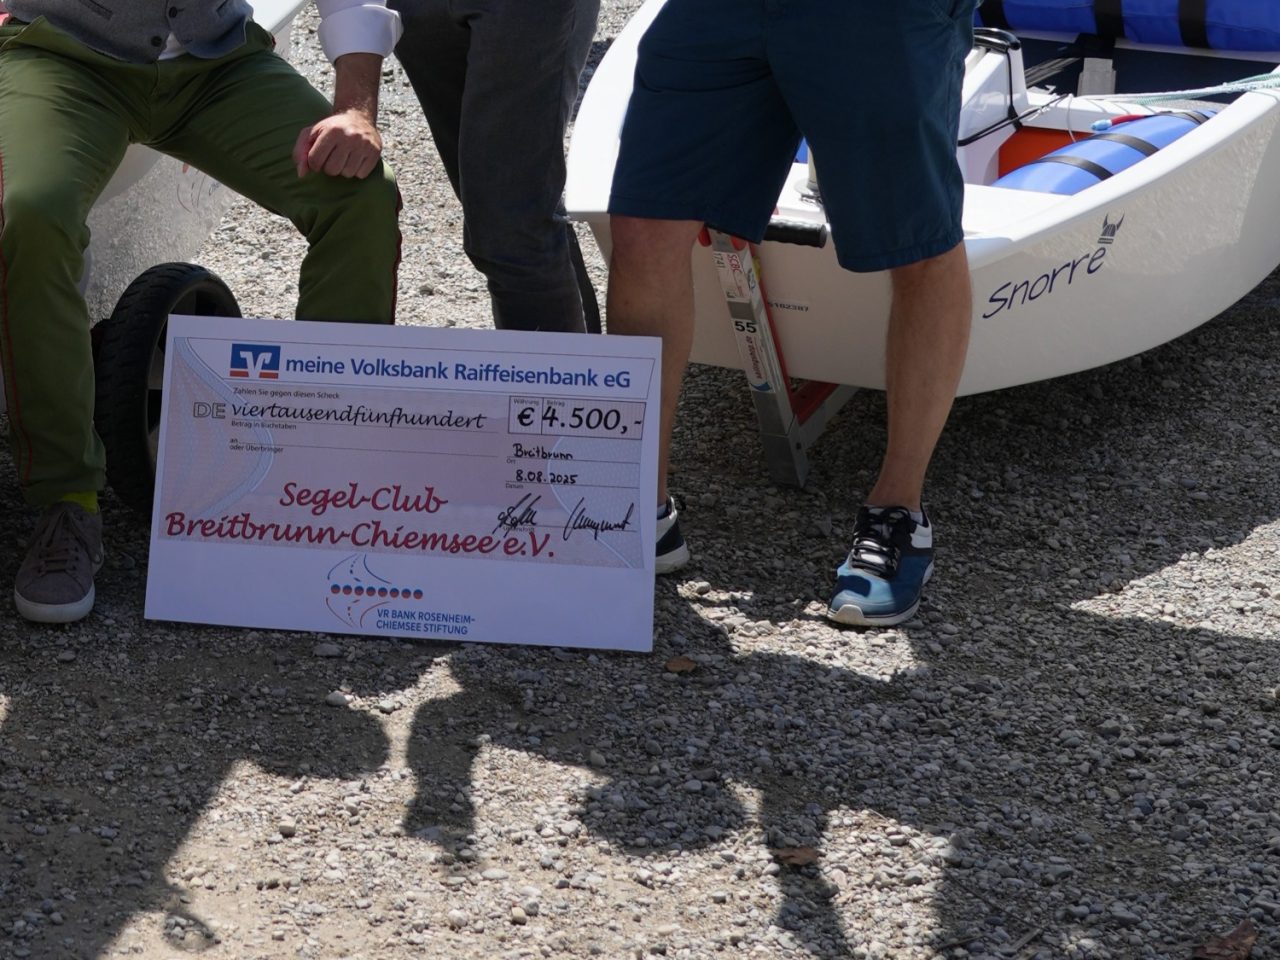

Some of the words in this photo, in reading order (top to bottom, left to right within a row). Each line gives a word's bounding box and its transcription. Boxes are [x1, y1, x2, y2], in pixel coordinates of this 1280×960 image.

[734, 320, 757, 334] 55
[285, 356, 345, 374] meine
[350, 358, 449, 381] Volksbank
[454, 363, 599, 388] Raiffeisenbank
[603, 371, 631, 389] eG
[233, 387, 257, 395] Zahlen
[193, 401, 226, 419] DE
[231, 404, 487, 428] viertausendfünfhundert
[518, 407, 535, 427] €
[542, 406, 643, 434] 4.500,-
[279, 482, 448, 515] Segel-Club
[165, 511, 501, 554] Breitbrunn-Chiemsee
[503, 531, 555, 558] e.V.
[376, 608, 390, 618] VR
[391, 610, 416, 620] BANK
[419, 611, 476, 624] ROSENHEIM-
[376, 620, 421, 632] CHIEMSEE
[423, 623, 468, 635] STIFTUNG
